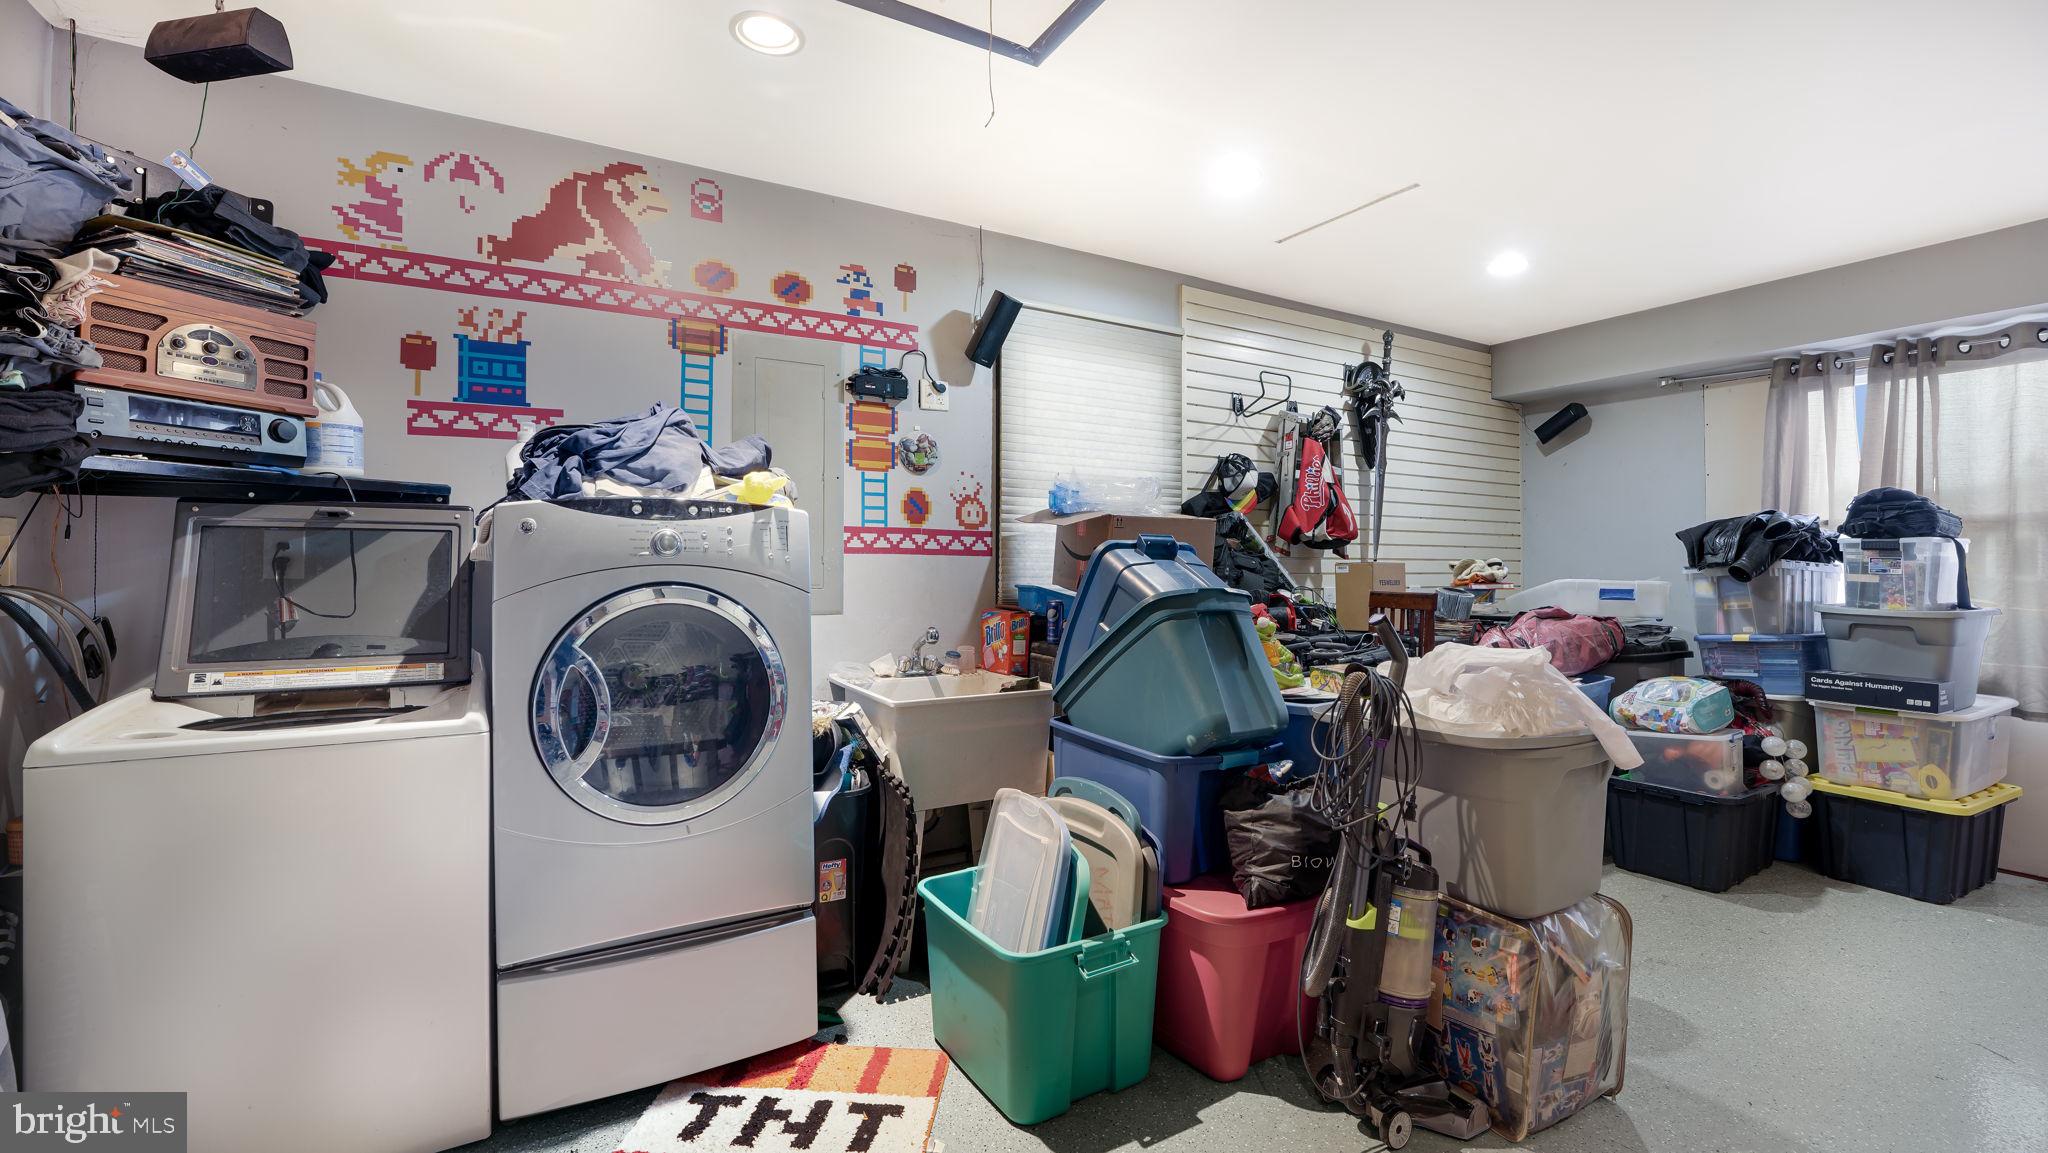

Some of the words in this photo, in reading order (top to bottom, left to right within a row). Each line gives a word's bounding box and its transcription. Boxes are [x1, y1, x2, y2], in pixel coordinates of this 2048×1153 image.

[472, 361, 523, 378] OIL
[194, 376, 224, 384] CROSLEY
[984, 620, 1006, 648] Brillo
[1810, 676, 1833, 685] Cards
[1834, 679, 1864, 688] Against
[1864, 682, 1904, 693] Humanity
[677, 1092, 905, 1152] TNT
